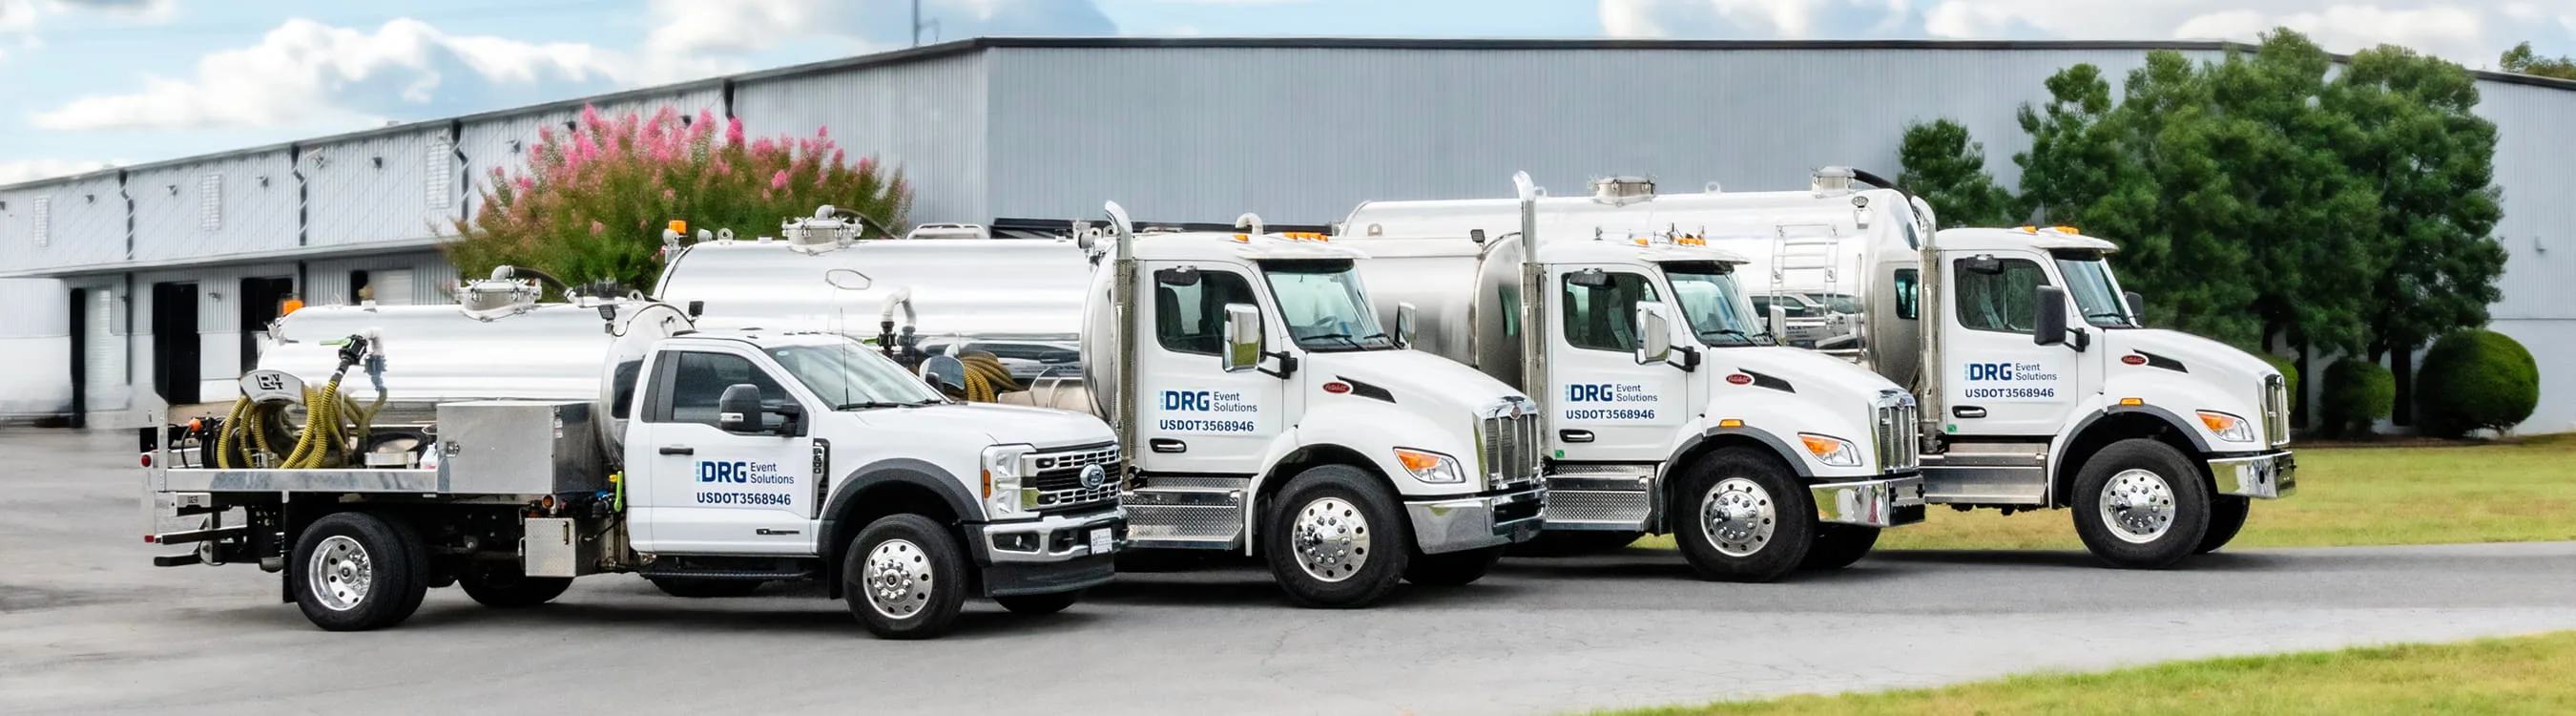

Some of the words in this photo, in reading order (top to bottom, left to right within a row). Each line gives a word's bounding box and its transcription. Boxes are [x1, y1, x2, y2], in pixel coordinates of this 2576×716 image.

[1970, 363, 2012, 381] DRG
[2015, 363, 2041, 371] Event
[2015, 372, 2057, 381] Solutions
[1570, 384, 1612, 402] DRG
[1616, 384, 1642, 392] Event
[1214, 391, 1240, 401] Event
[1616, 393, 1658, 402] Solutions
[1965, 389, 2054, 398] USDOT3568946
[1166, 390, 1210, 411] DRG
[1214, 402, 1257, 412] Solutions
[1566, 410, 1655, 420] USDOT3568946
[1159, 419, 1255, 432] USDOT3568946
[701, 461, 747, 483] DRG
[750, 462, 777, 472] Event
[750, 474, 795, 484] Solutions
[696, 492, 792, 505] USDOT3568946
